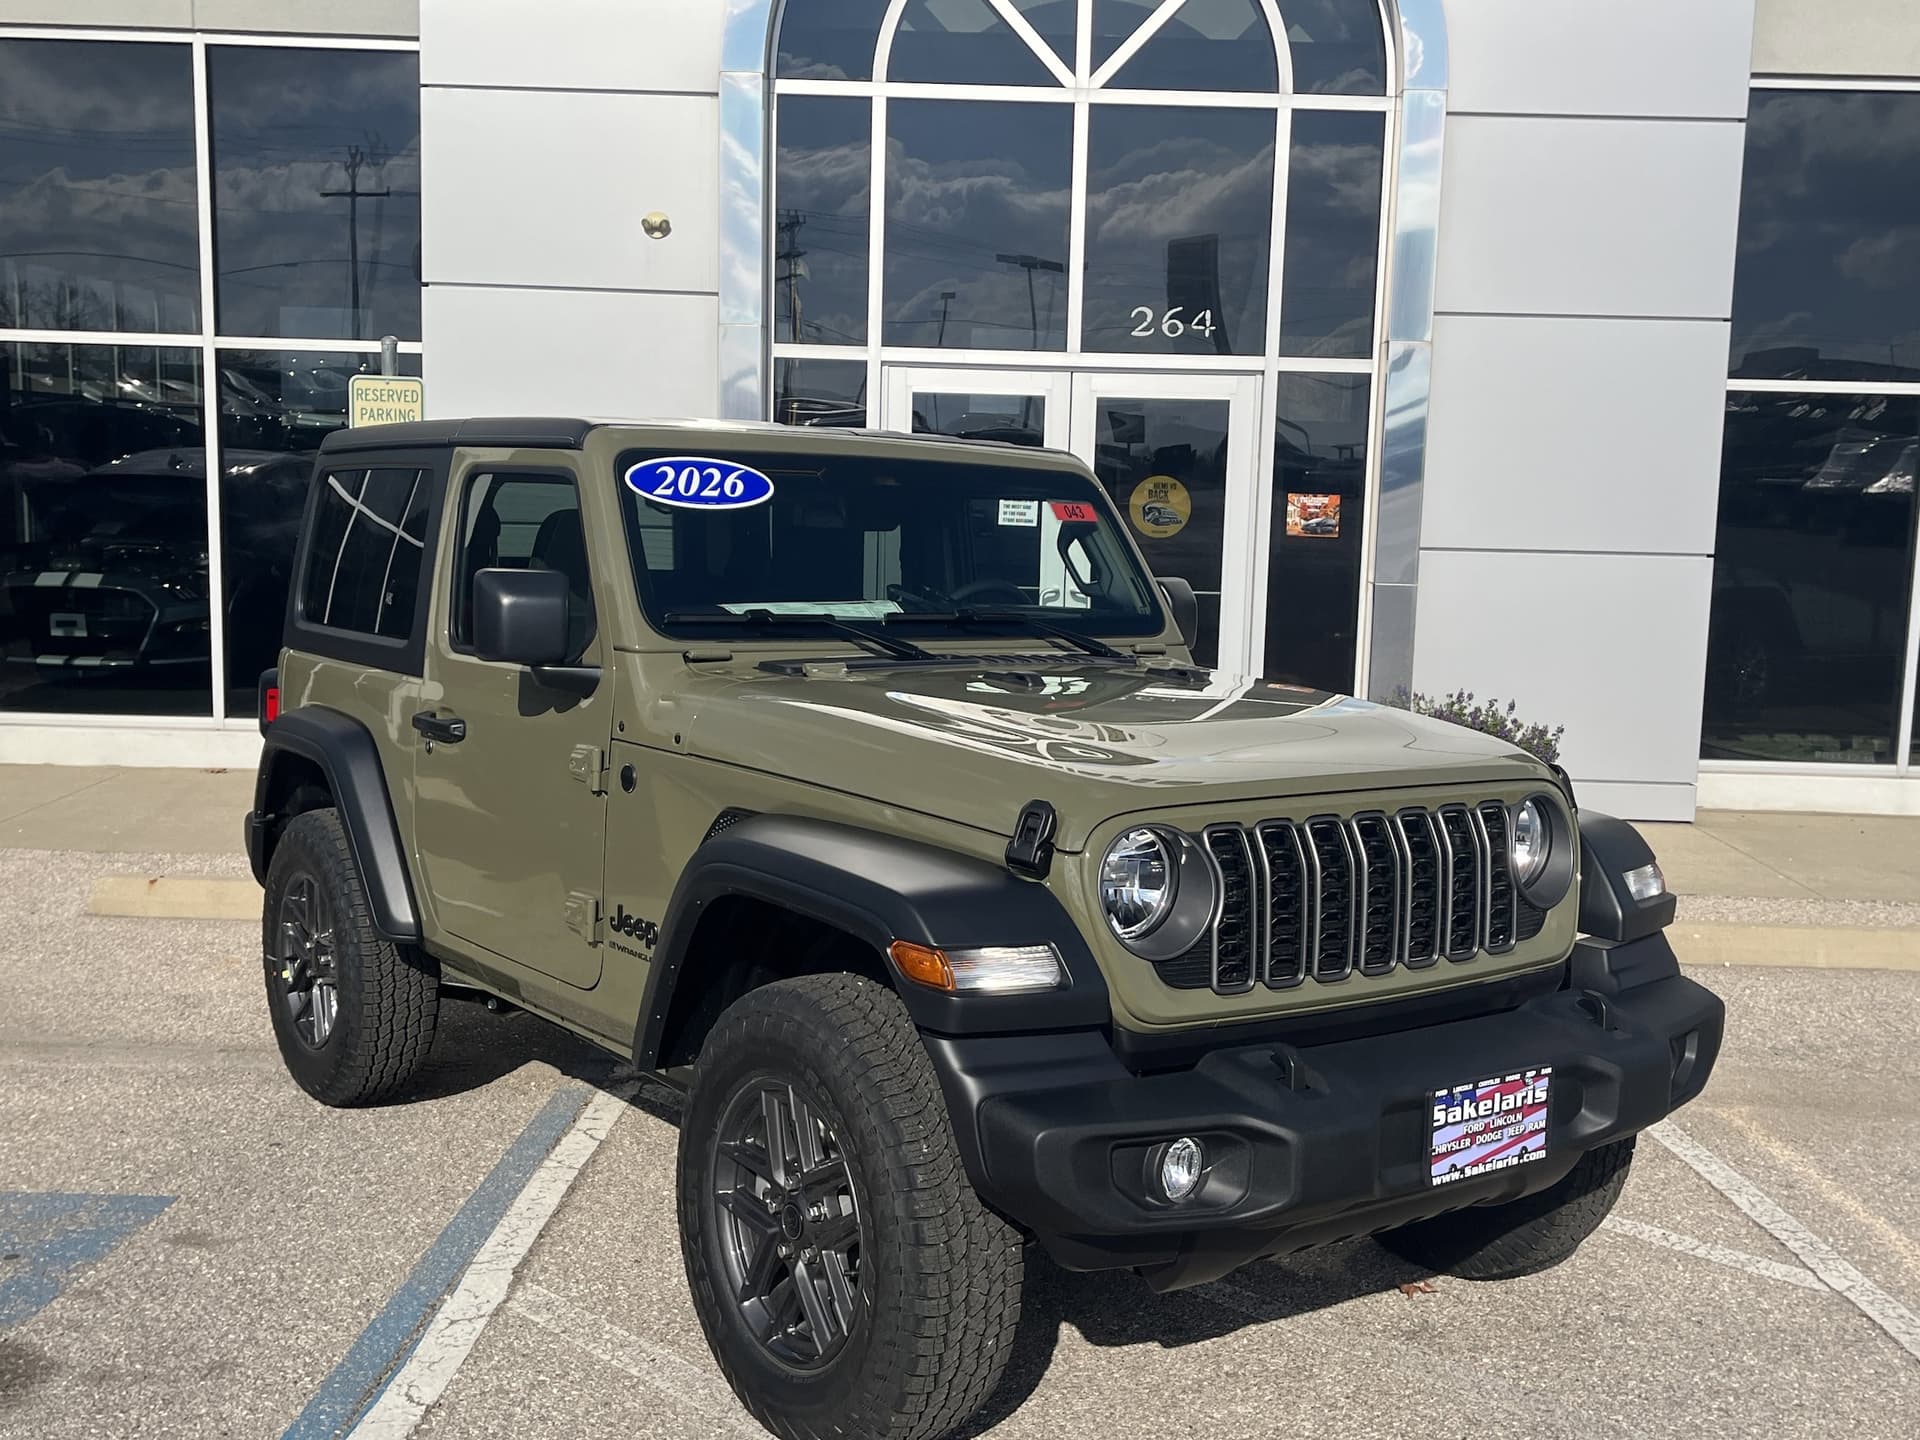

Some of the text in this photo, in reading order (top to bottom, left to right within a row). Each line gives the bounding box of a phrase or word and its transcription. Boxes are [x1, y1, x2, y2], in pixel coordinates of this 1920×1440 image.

[1130, 306, 1217, 338] 264
[356, 388, 419, 403] RESERVED
[360, 407, 416, 422] PARKING
[652, 465, 746, 498] 2026
[1148, 489, 1169, 500] BACK
[1063, 505, 1085, 519] 043
[610, 904, 659, 950] Jeep
[1432, 1085, 1549, 1127] Sakelaris
[1463, 1112, 1523, 1135] FORD LINCOLN
[1476, 1130, 1503, 1145] DODGE
[1508, 1125, 1525, 1137] JEEP
[1528, 1119, 1546, 1132] RAM
[1432, 1149, 1546, 1187] www.Sakelaris.com
